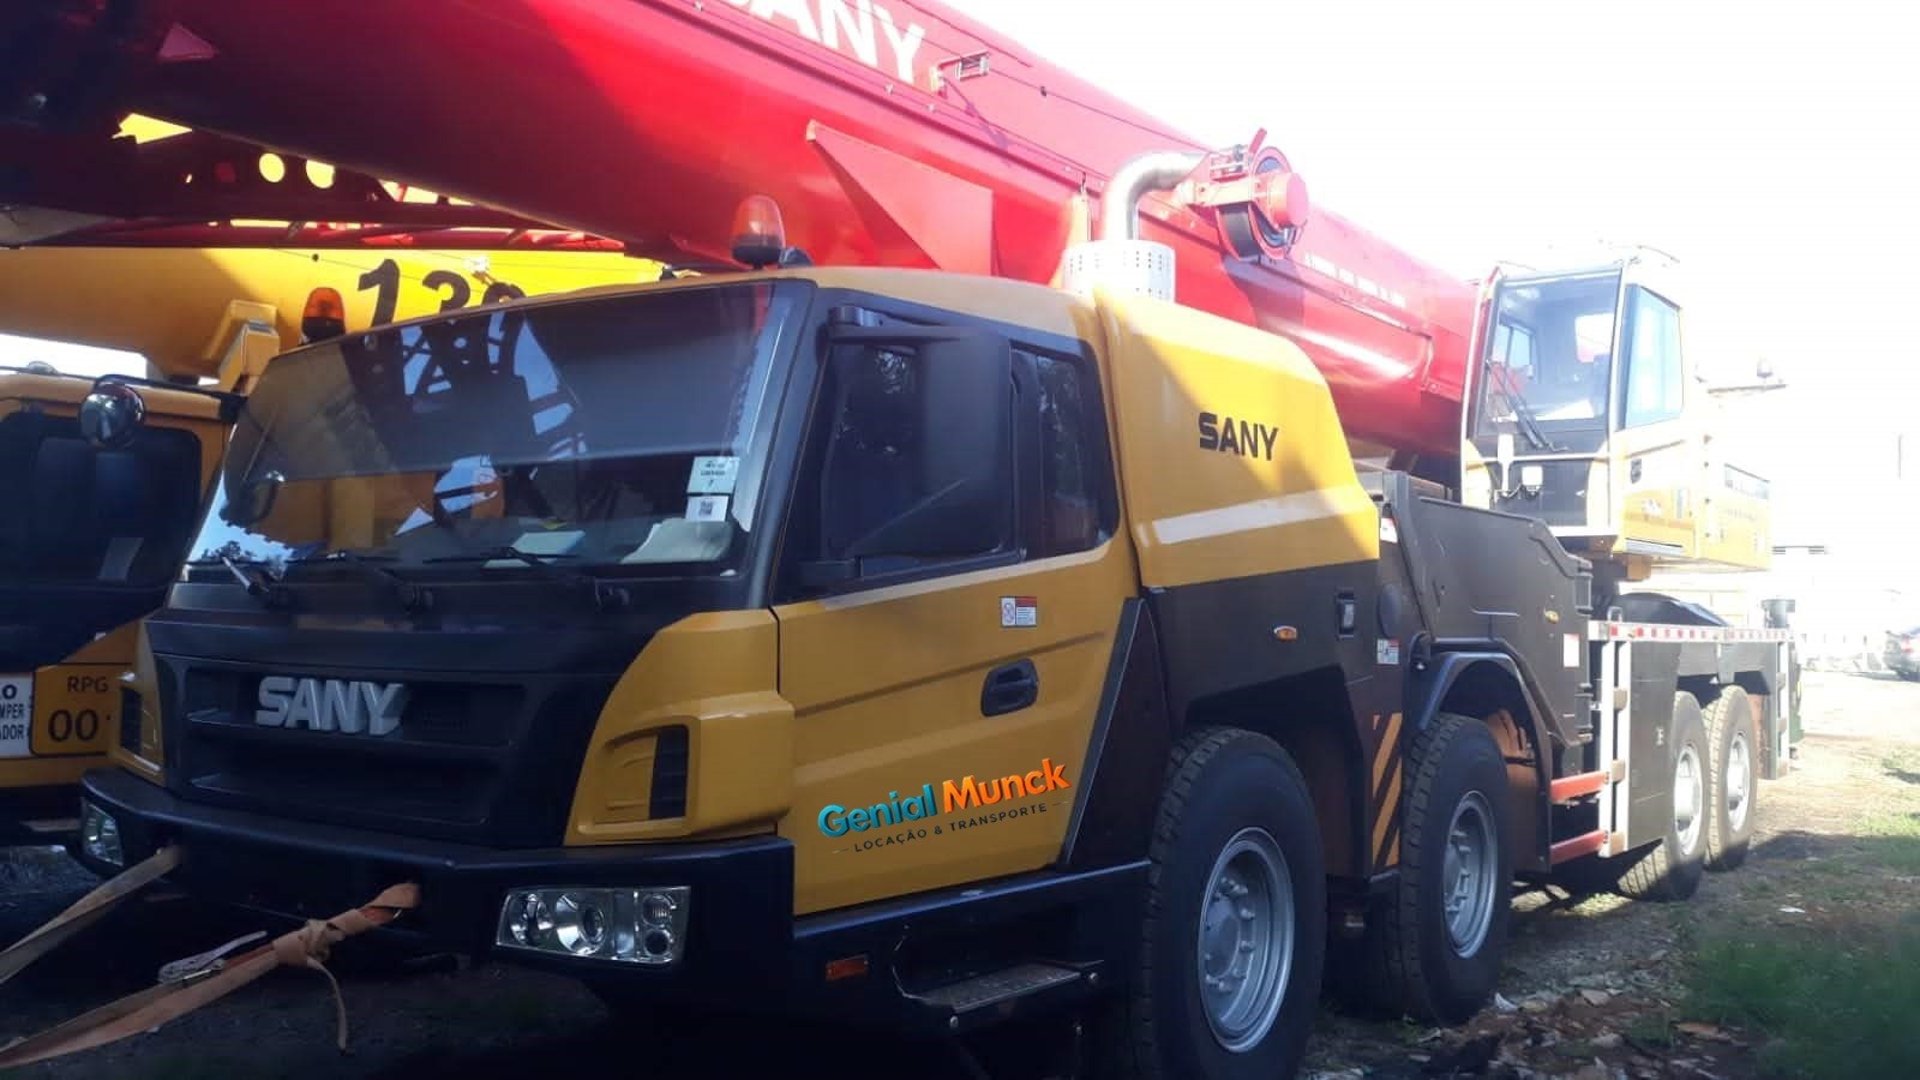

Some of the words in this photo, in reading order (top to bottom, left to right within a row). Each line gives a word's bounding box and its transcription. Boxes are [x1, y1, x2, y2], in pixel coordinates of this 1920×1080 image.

[722, 0, 926, 85] ANY
[1198, 412, 1279, 461] SANY
[67, 675, 109, 692] RPG
[255, 676, 404, 736] SANY
[817, 783, 938, 838] Genial
[942, 758, 1072, 814] Munck
[853, 828, 927, 853] LOCAÇÃO
[933, 825, 943, 836] &
[949, 803, 1047, 832] TRANSPORTE
